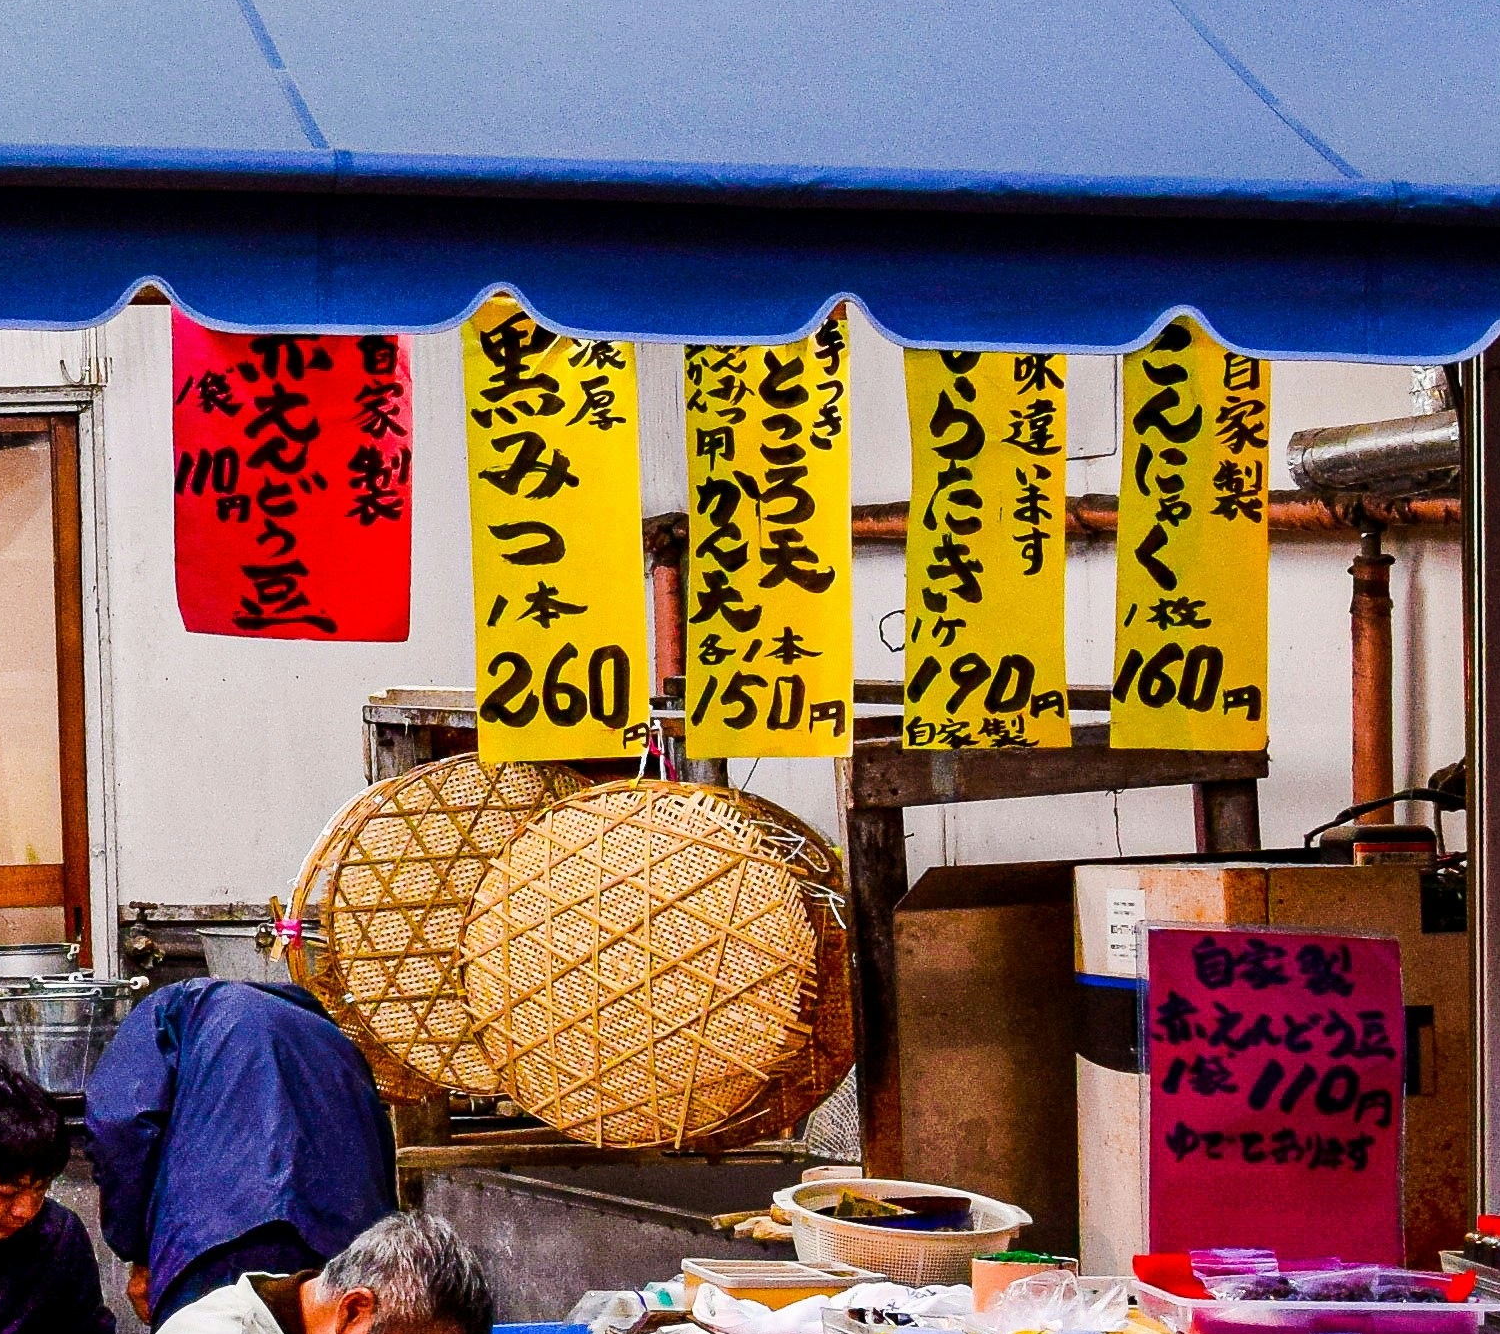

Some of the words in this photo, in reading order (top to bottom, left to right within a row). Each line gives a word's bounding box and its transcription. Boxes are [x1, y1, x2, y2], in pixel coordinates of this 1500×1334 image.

[566, 337, 627, 430] 濃厚
[346, 335, 409, 526] 自家製
[470, 310, 579, 566] 黒みつ
[1134, 323, 1202, 592] こんにゃく
[1212, 354, 1268, 523] 自家製
[758, 349, 836, 593] ところ天
[479, 642, 649, 748] 260円
[691, 671, 845, 737] 150円
[907, 654, 1065, 719] 190円
[1112, 644, 1261, 722] 160円
[905, 715, 1039, 749] 自家製
[1192, 936, 1355, 997] 自家製
[1152, 990, 1396, 1058] 赤えんどう豆
[1248, 1059, 1392, 1128] 110円
[1166, 1121, 1376, 1171] ゆでてあります
